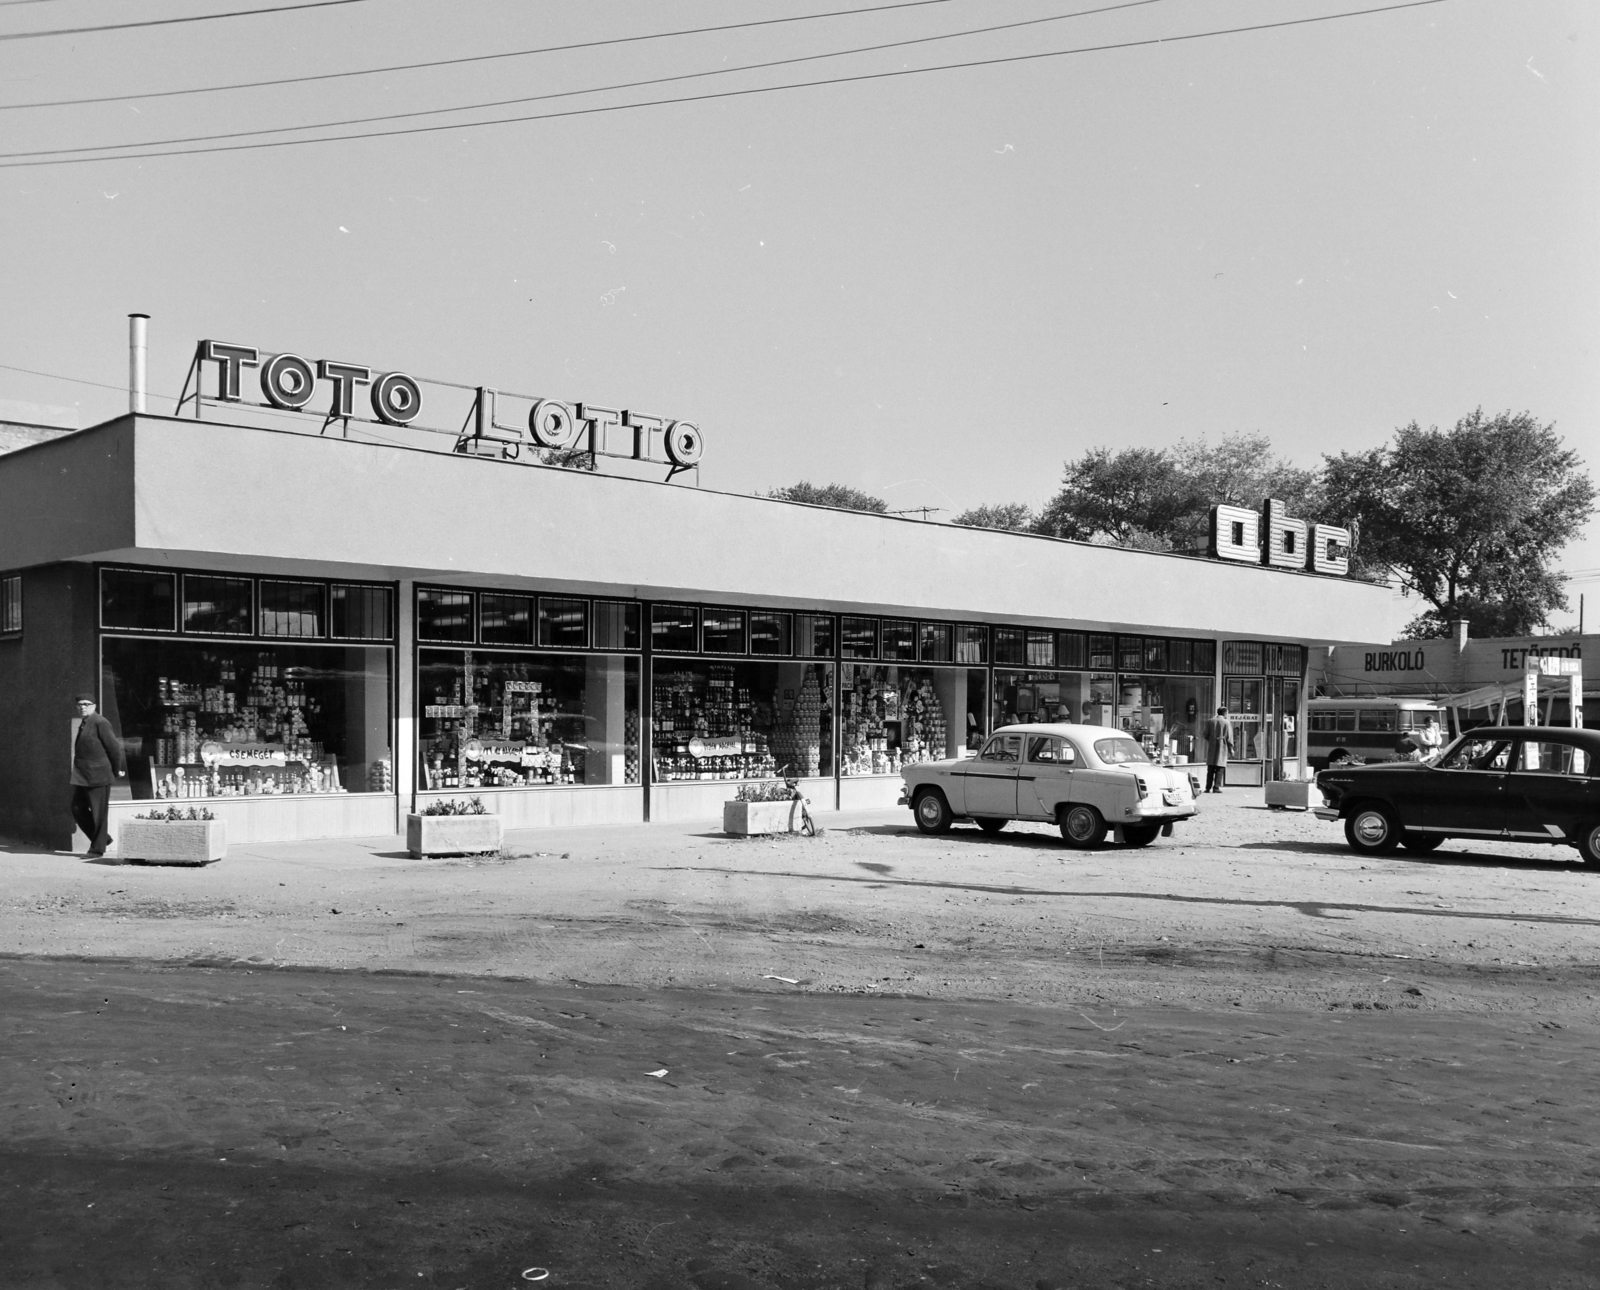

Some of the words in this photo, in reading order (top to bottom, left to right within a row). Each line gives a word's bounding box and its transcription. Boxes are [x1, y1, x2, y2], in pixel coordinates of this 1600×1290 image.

[200, 339, 422, 427] TOTO
[475, 386, 706, 467] LOTTO
[1209, 498, 1350, 576] abc
[1265, 646, 1283, 671] ABC
[1365, 647, 1425, 672] BURKOLÓ
[229, 748, 275, 760] CSEMEGÉT
